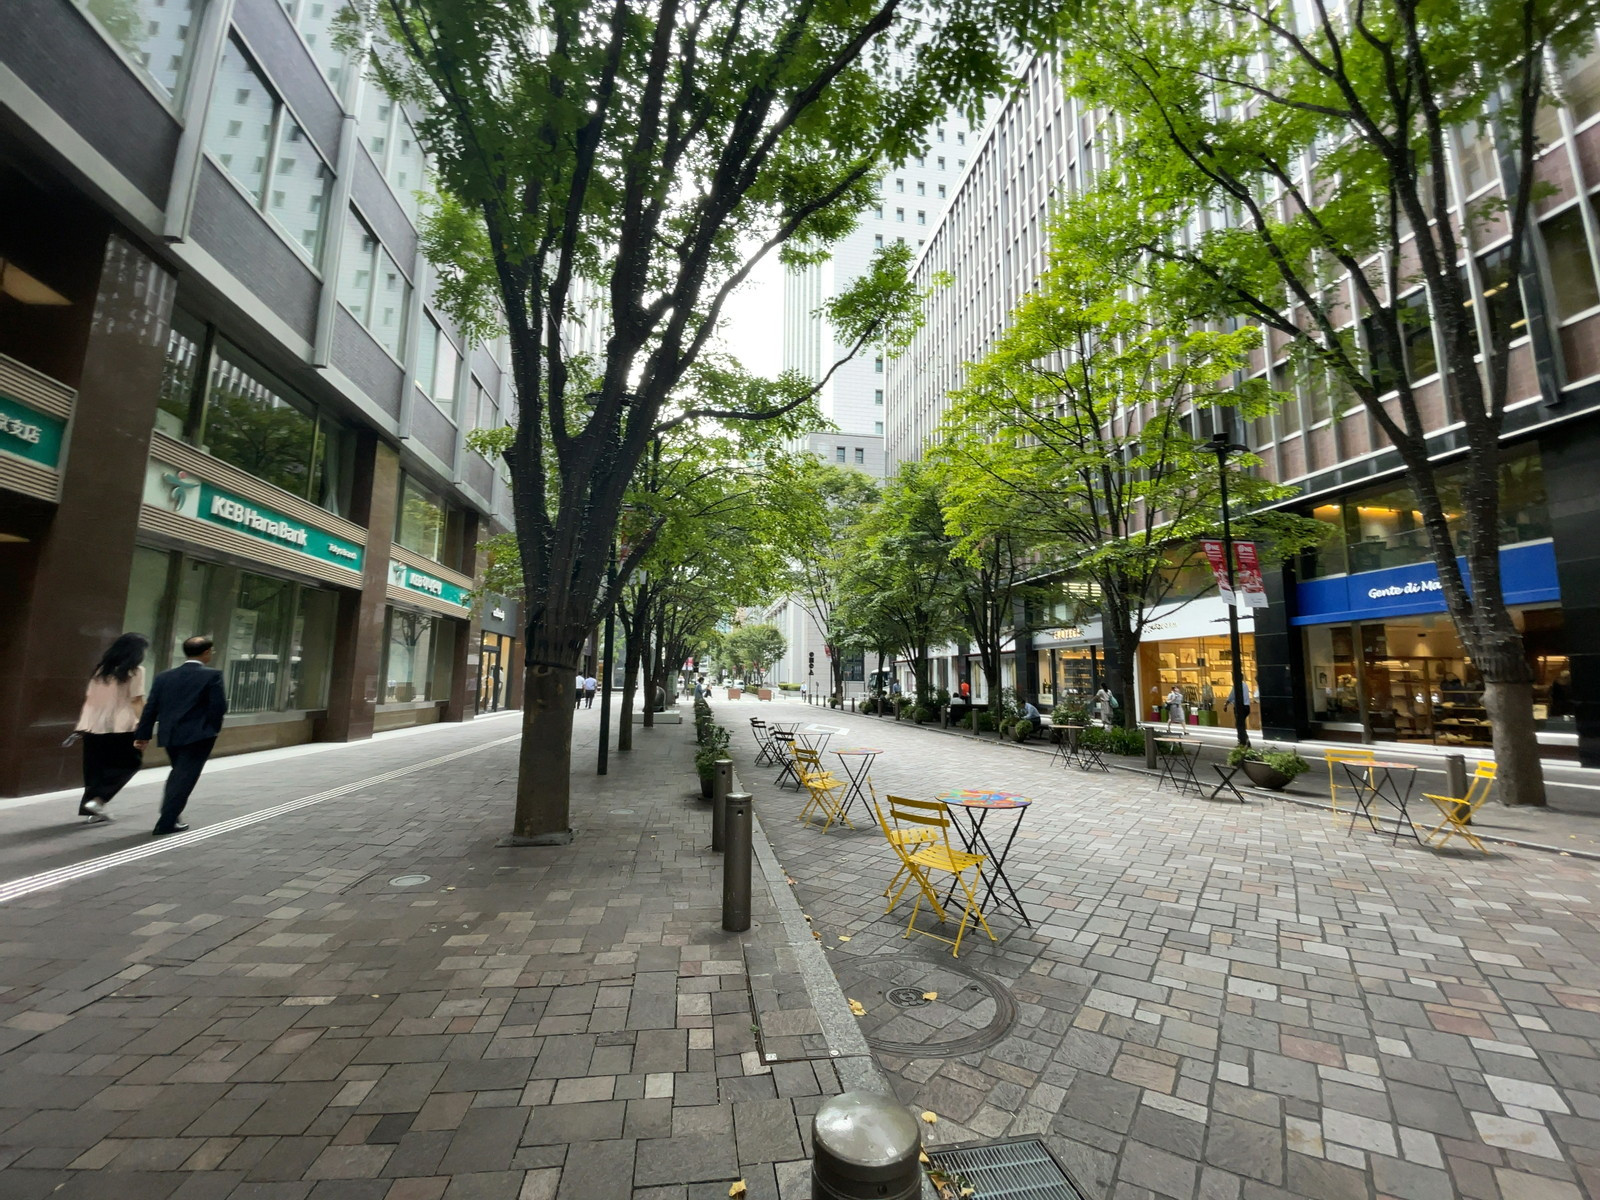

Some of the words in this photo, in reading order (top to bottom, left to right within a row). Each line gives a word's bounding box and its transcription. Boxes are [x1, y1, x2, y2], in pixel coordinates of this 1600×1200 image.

[210, 495, 245, 523] KEB
[244, 507, 279, 536] Hana
[278, 521, 308, 546] Bank
[1368, 585, 1404, 599] Gente
[1404, 581, 1421, 594] di
